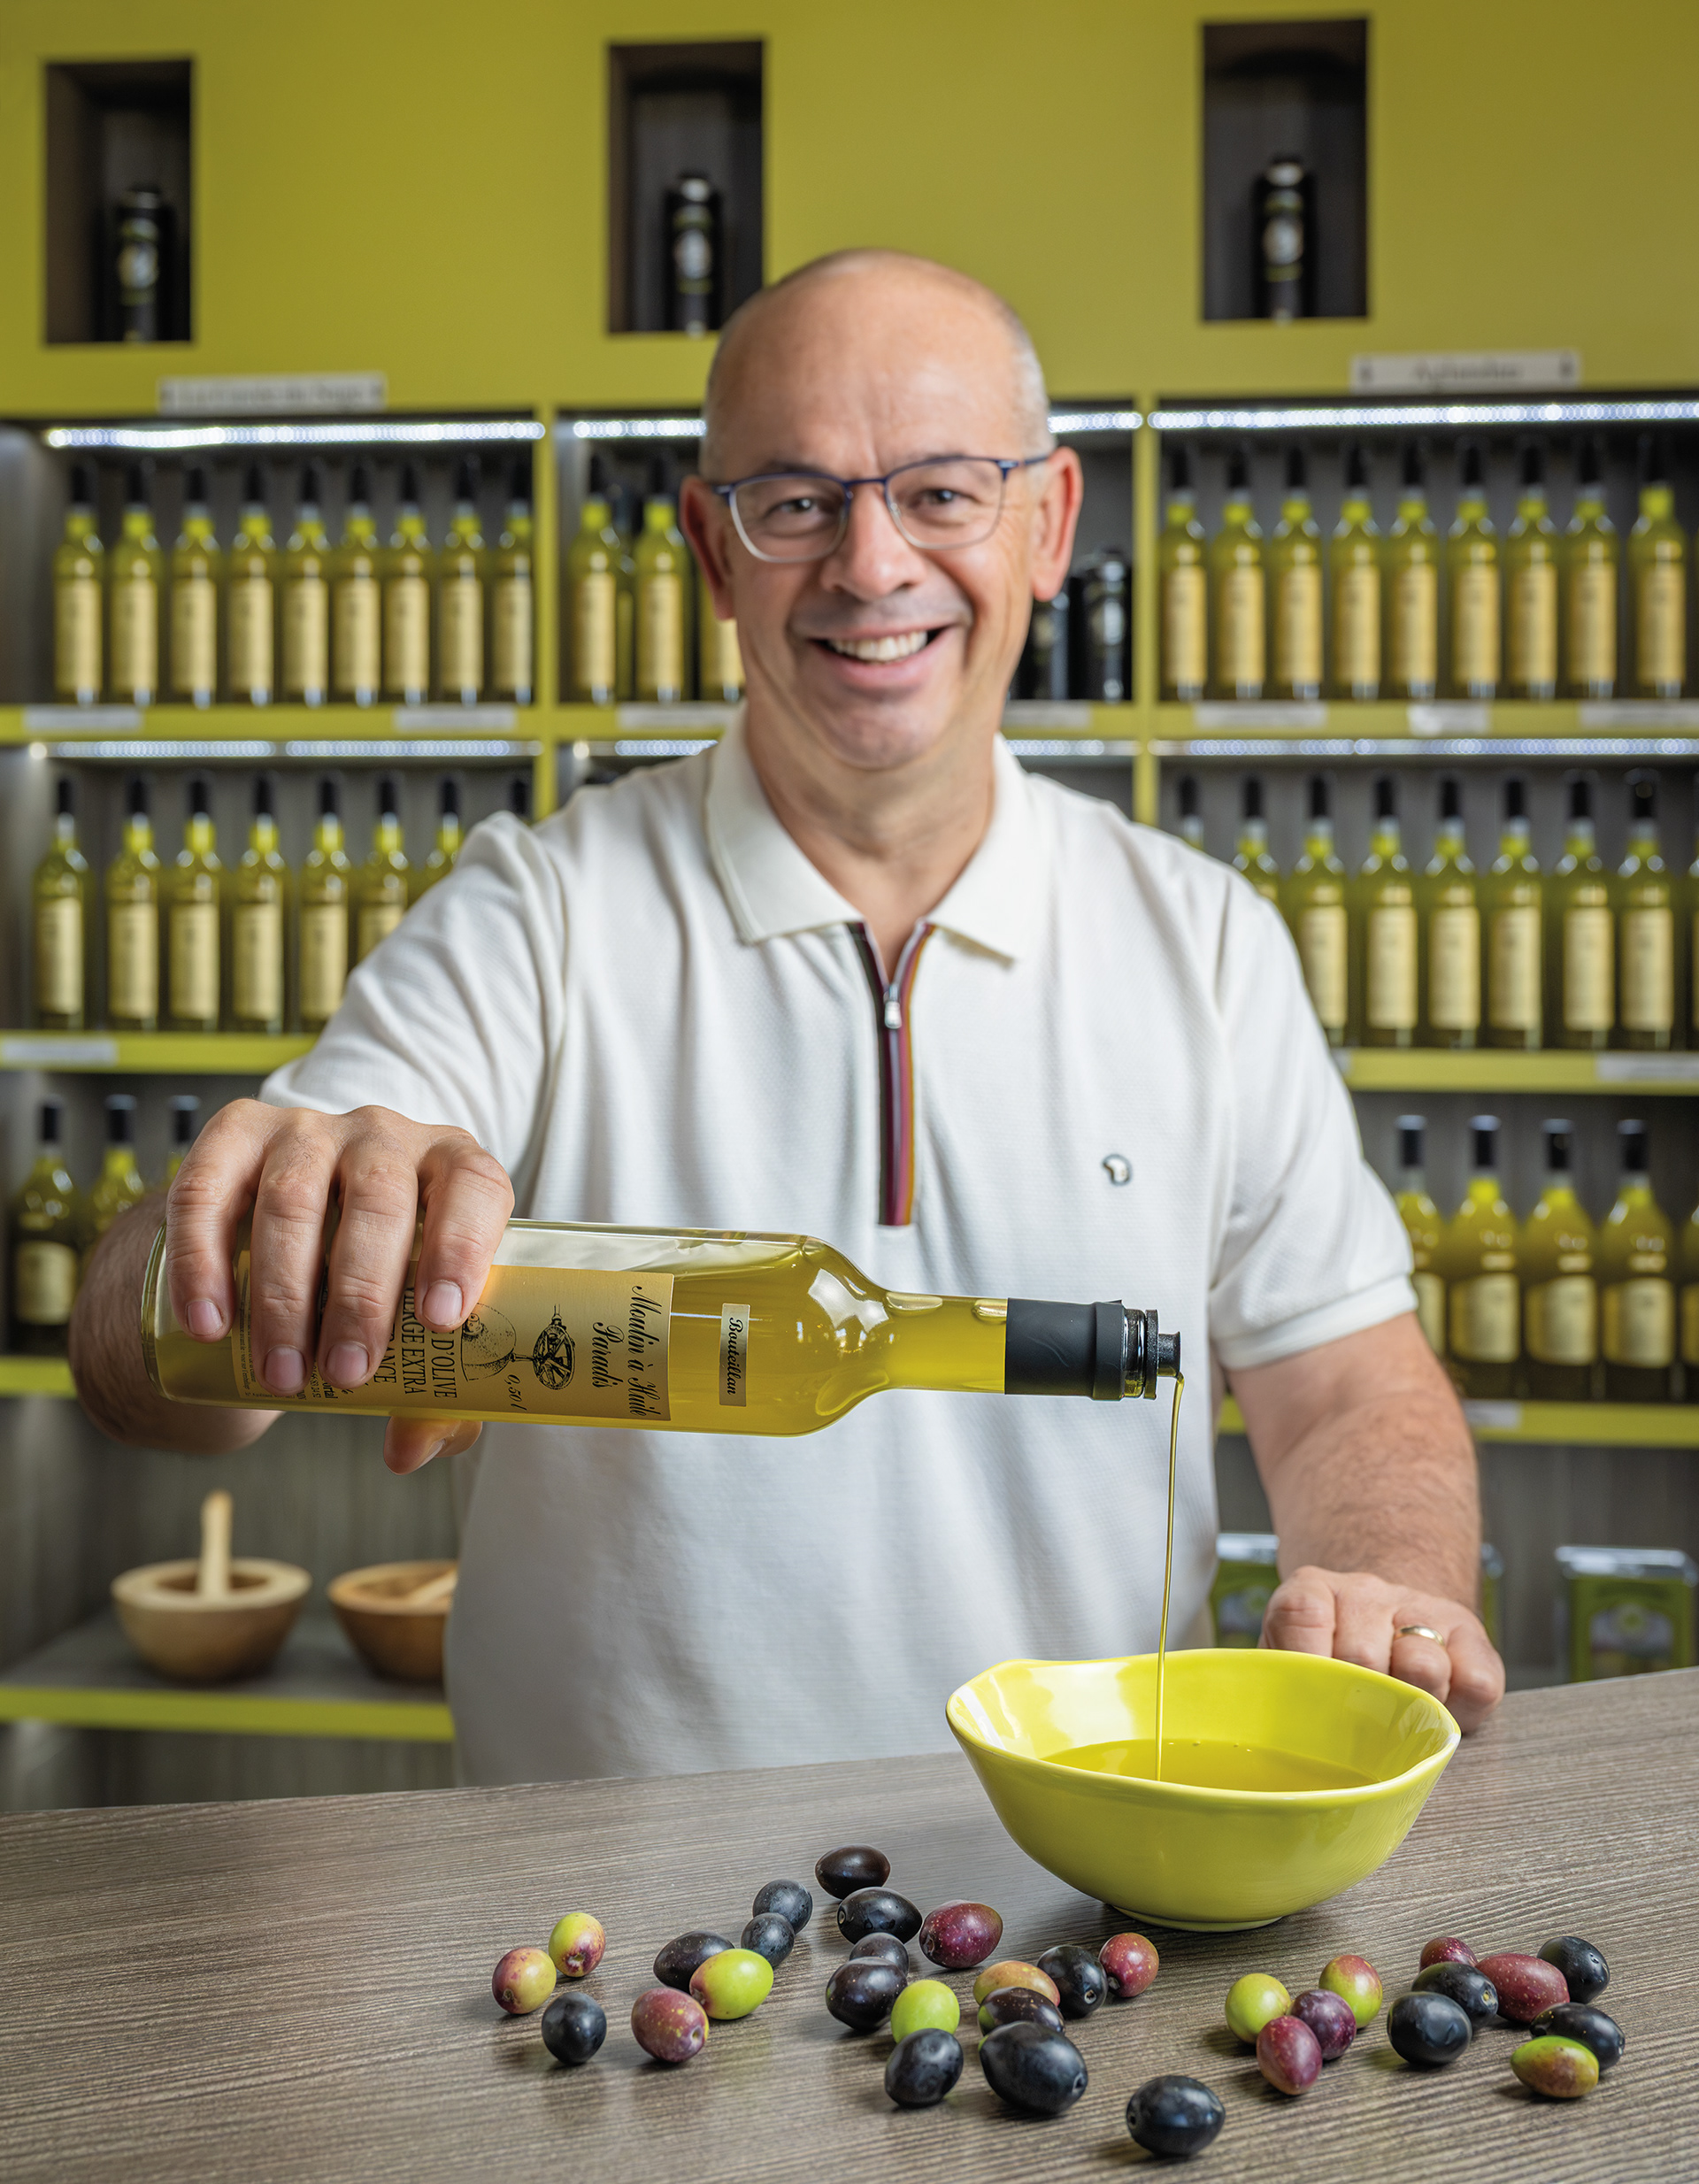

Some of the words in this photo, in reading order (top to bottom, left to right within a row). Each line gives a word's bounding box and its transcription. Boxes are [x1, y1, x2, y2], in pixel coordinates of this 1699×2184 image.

[627, 1286, 663, 1355] Moulin
[402, 1348, 427, 1395] EXTRA
[431, 1339, 458, 1399] D'OLIVE
[591, 1322, 625, 1388] Paradis
[627, 1359, 653, 1372] à
[726, 1318, 744, 1396] Bouteillan
[504, 1374, 522, 1402] 0,50
[627, 1378, 661, 1417] Huile
